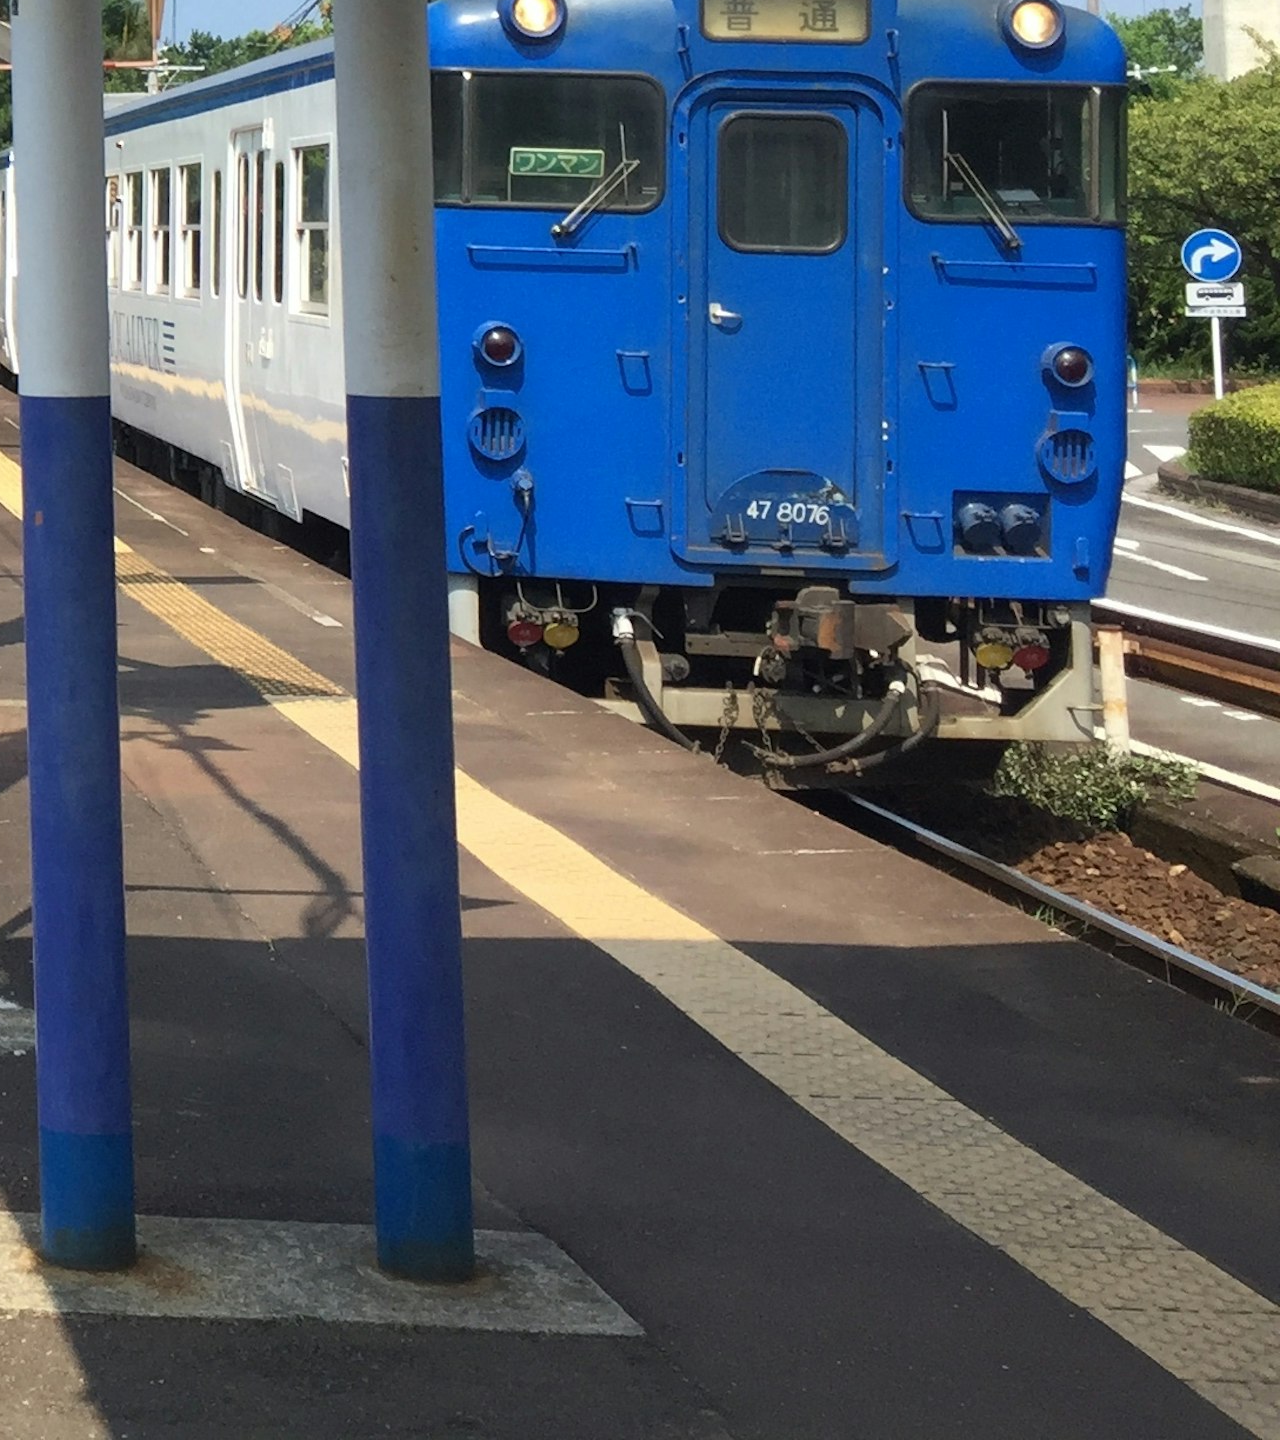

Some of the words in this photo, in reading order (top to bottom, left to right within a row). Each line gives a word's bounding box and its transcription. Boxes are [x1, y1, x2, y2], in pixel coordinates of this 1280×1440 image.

[720, 0, 838, 32] 普通
[515, 153, 598, 173] ワンマン
[746, 500, 772, 520] 47
[776, 501, 830, 526] 8076
